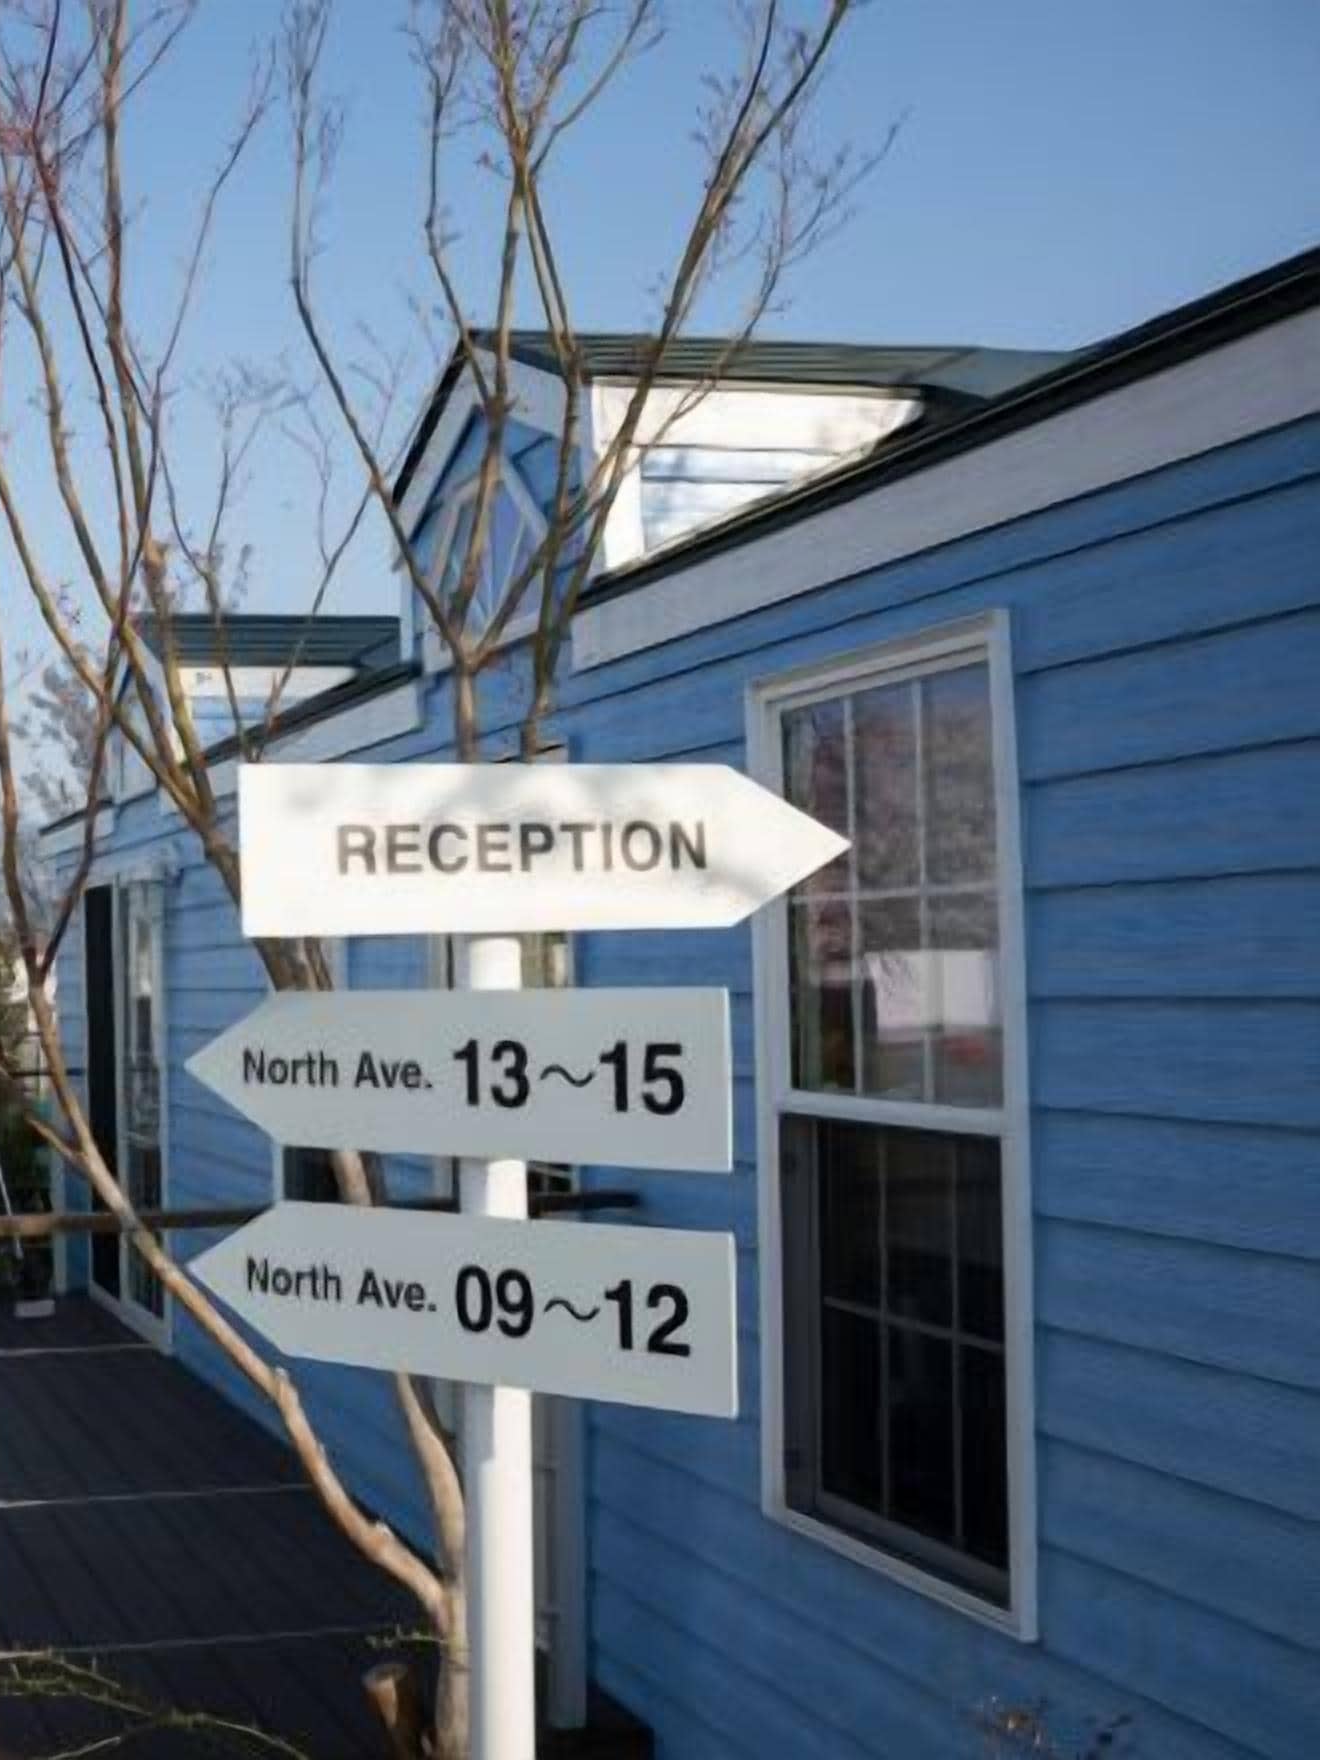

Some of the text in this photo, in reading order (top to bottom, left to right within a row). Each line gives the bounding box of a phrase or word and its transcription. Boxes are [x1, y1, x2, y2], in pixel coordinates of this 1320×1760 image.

[337, 819, 708, 875] RECEPTION
[242, 1047, 339, 1088] North
[353, 1050, 434, 1091] Ave.
[246, 1256, 343, 1303] North
[356, 1268, 438, 1313] Ave.
